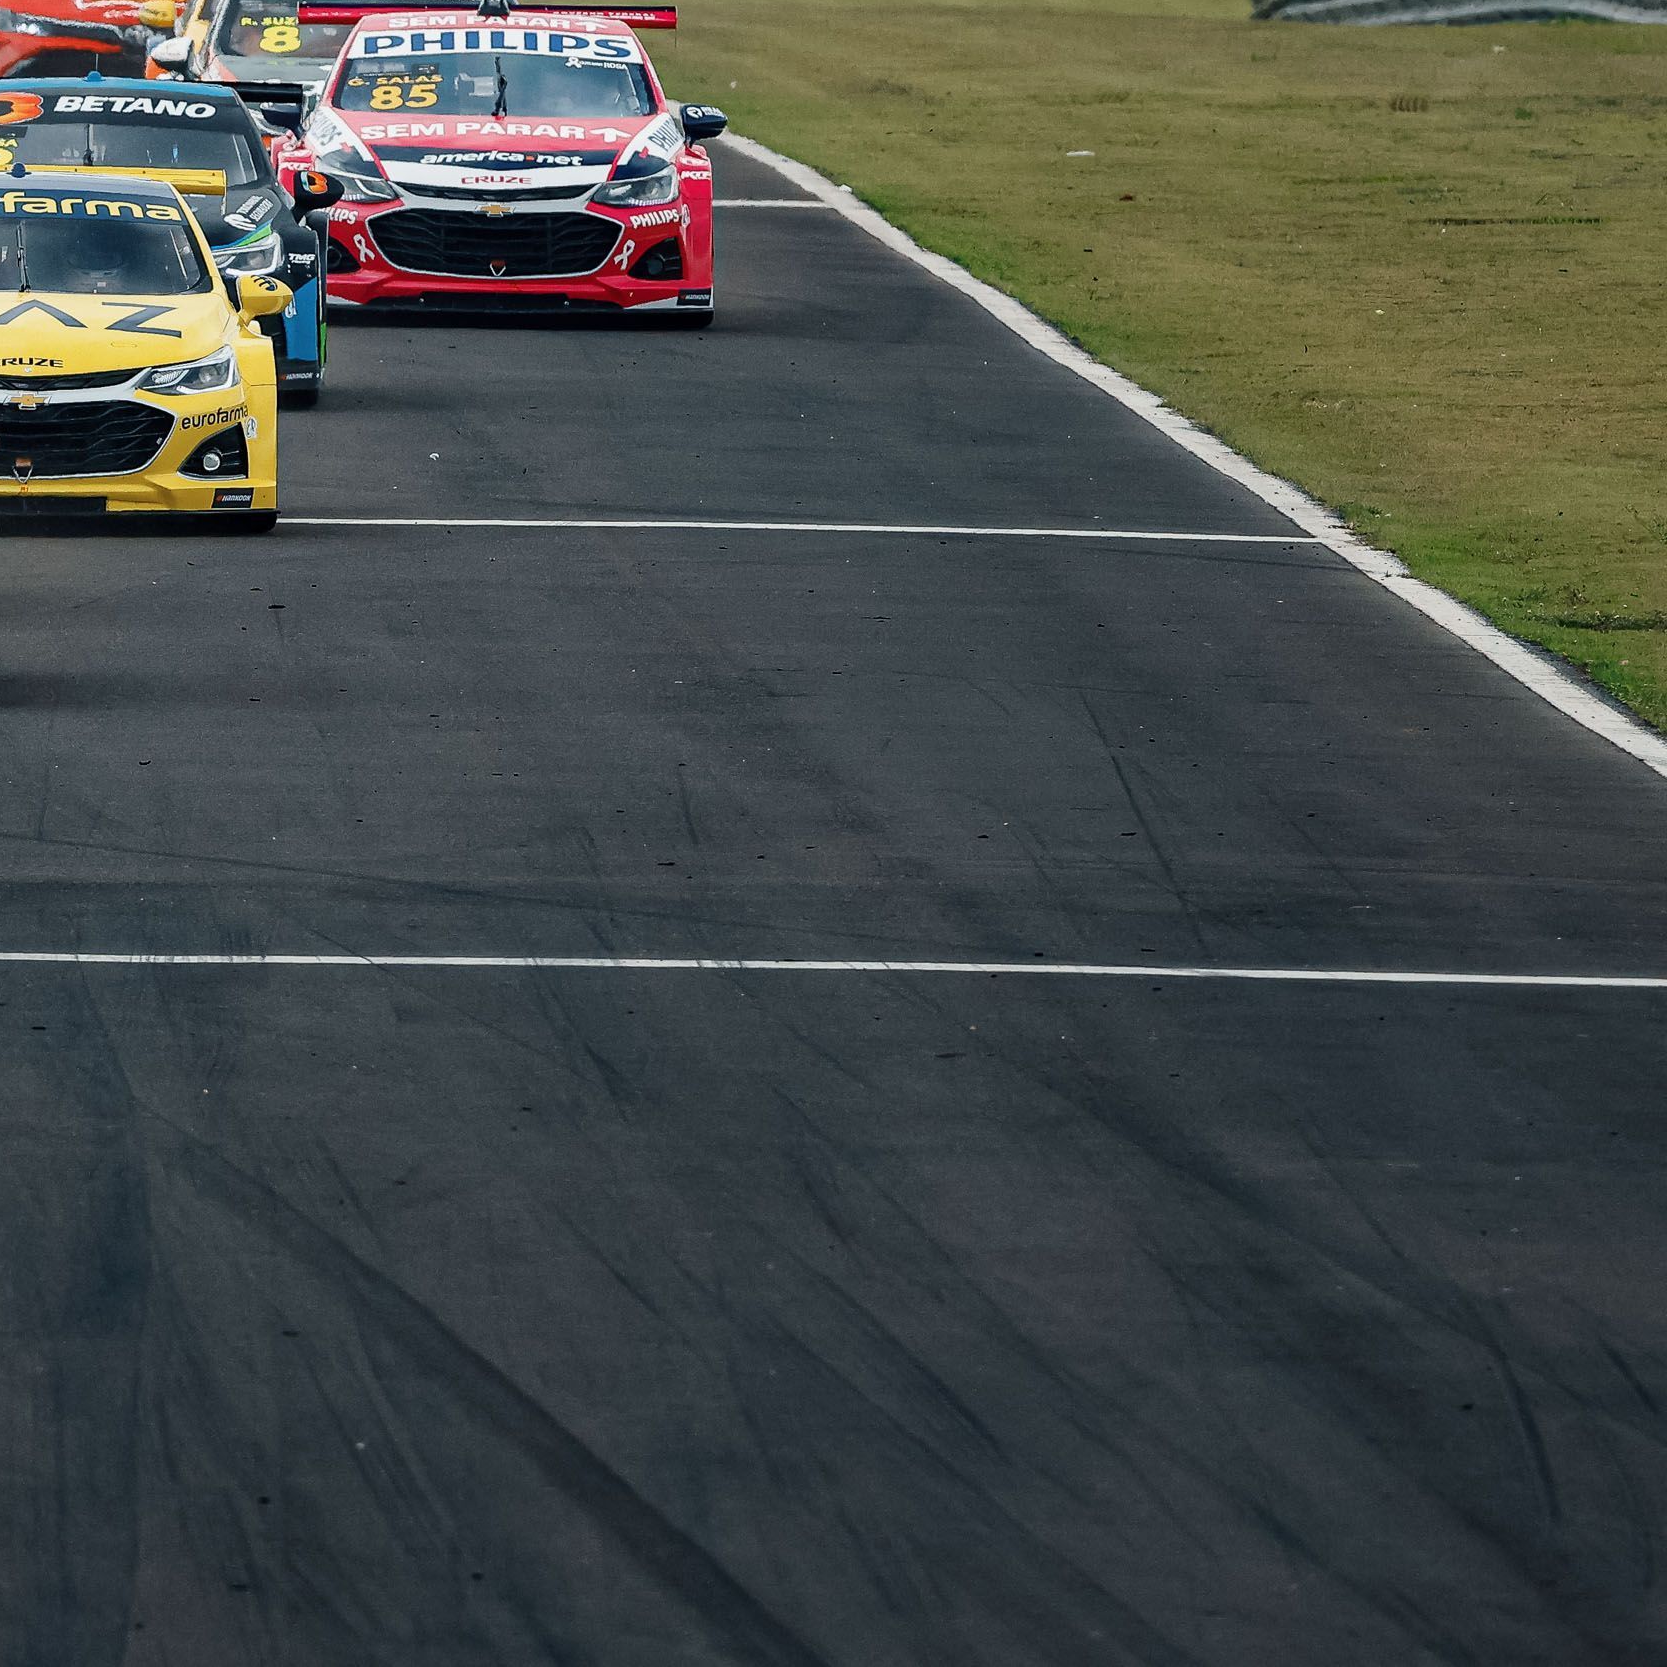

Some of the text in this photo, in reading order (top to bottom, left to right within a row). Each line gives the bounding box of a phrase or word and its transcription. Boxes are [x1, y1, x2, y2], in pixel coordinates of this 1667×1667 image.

[389, 14, 458, 29] SEM
[467, 14, 568, 30] PARAR
[260, 25, 302, 53] 8
[364, 31, 633, 58] PHILIPS
[377, 74, 444, 84] SALAS
[54, 96, 217, 119] BETANO
[369, 83, 439, 111] 85
[360, 124, 444, 140] SEM
[457, 122, 585, 140] PARAR
[461, 175, 533, 185] CRUZE
[630, 207, 680, 229] PHILIPS
[288, 253, 316, 262] TMG
[181, 405, 248, 429] eurofarma
